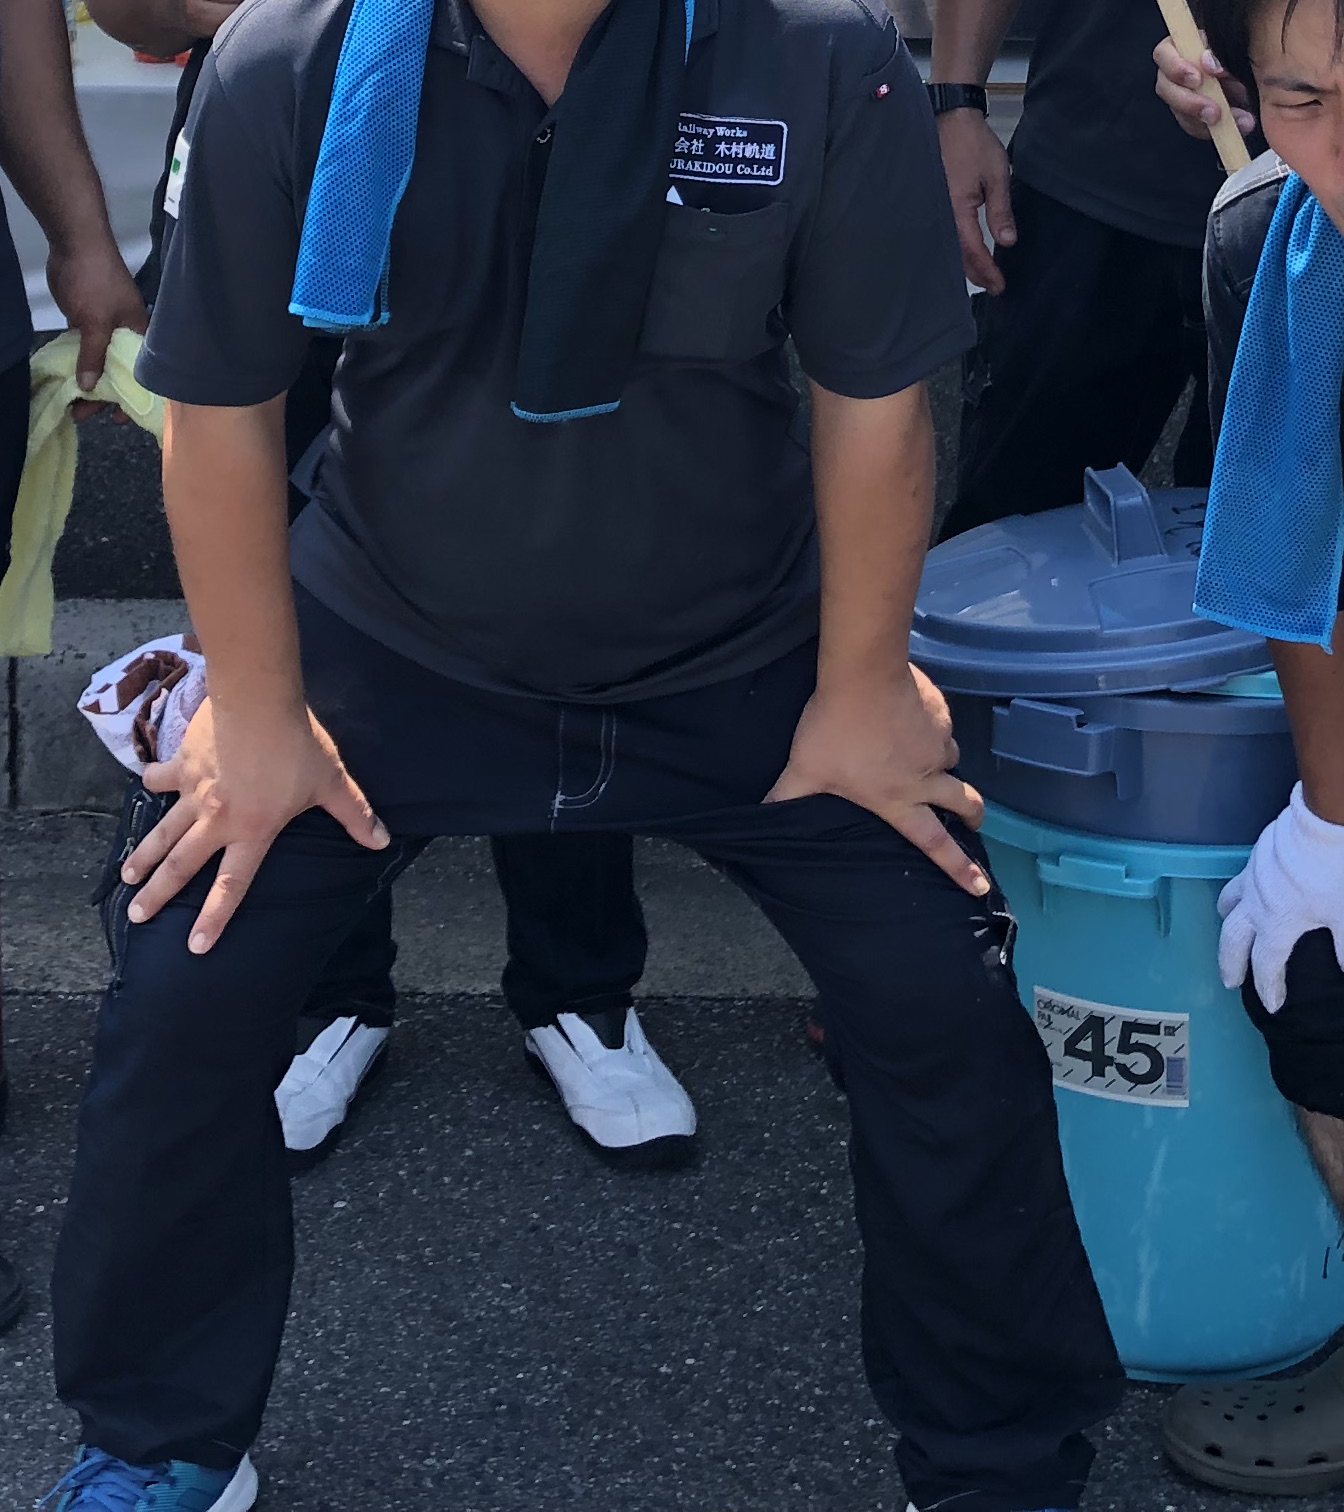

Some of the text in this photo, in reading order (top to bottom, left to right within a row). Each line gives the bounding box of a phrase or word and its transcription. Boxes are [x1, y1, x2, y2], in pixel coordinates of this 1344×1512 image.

[714, 126, 749, 138] Works
[674, 136, 777, 160] 会社 木村軌道
[1063, 1014, 1164, 1085] 45
